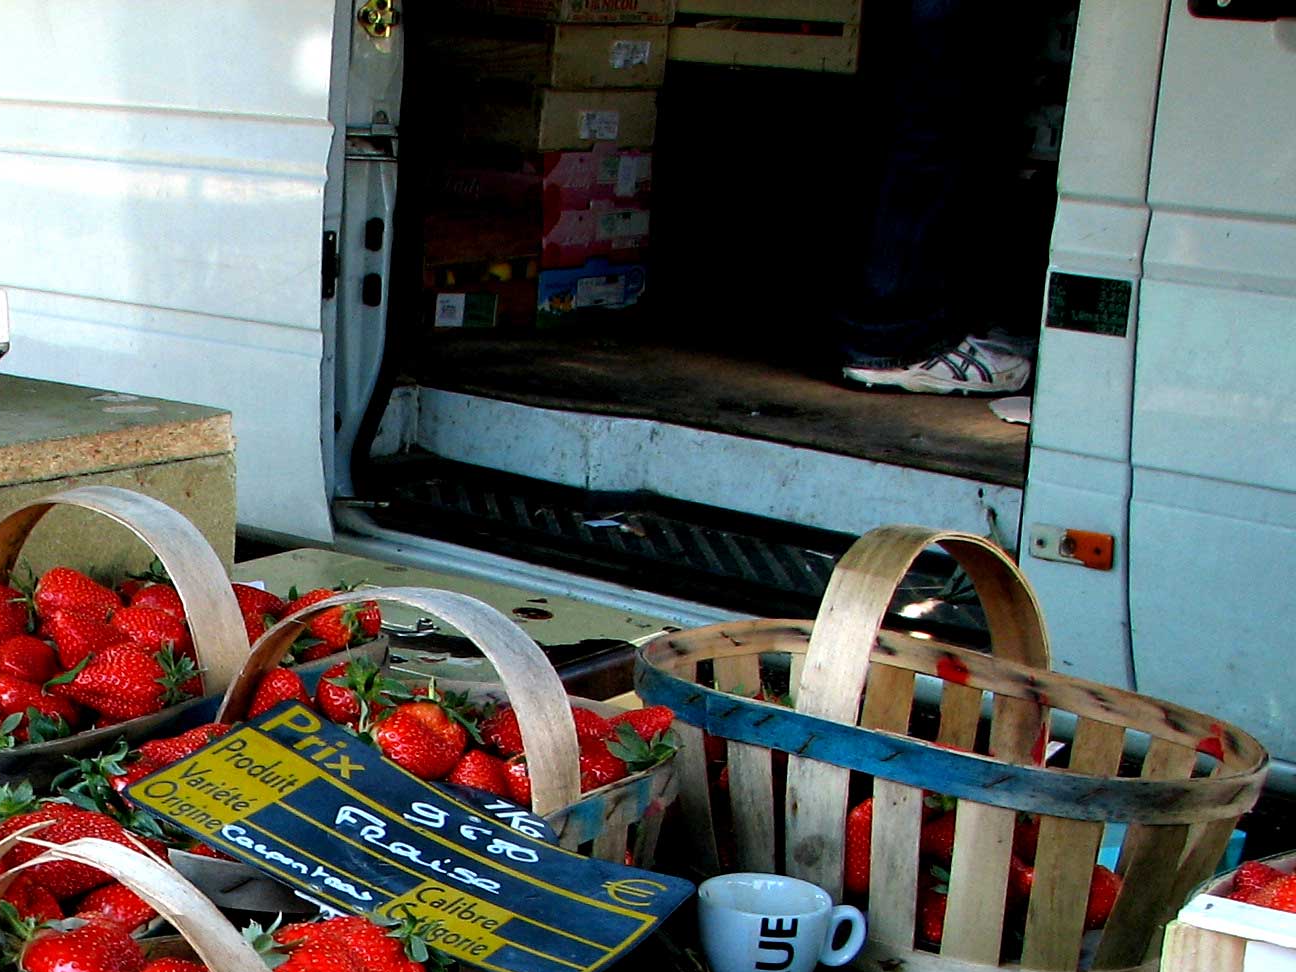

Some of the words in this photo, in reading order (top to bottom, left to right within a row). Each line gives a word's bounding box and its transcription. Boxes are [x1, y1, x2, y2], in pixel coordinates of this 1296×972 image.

[212, 738, 298, 793] Produit
[259, 704, 365, 779] Prix
[144, 780, 223, 830] Origine
[179, 761, 256, 812] Variété
[416, 887, 499, 930] Calibre
